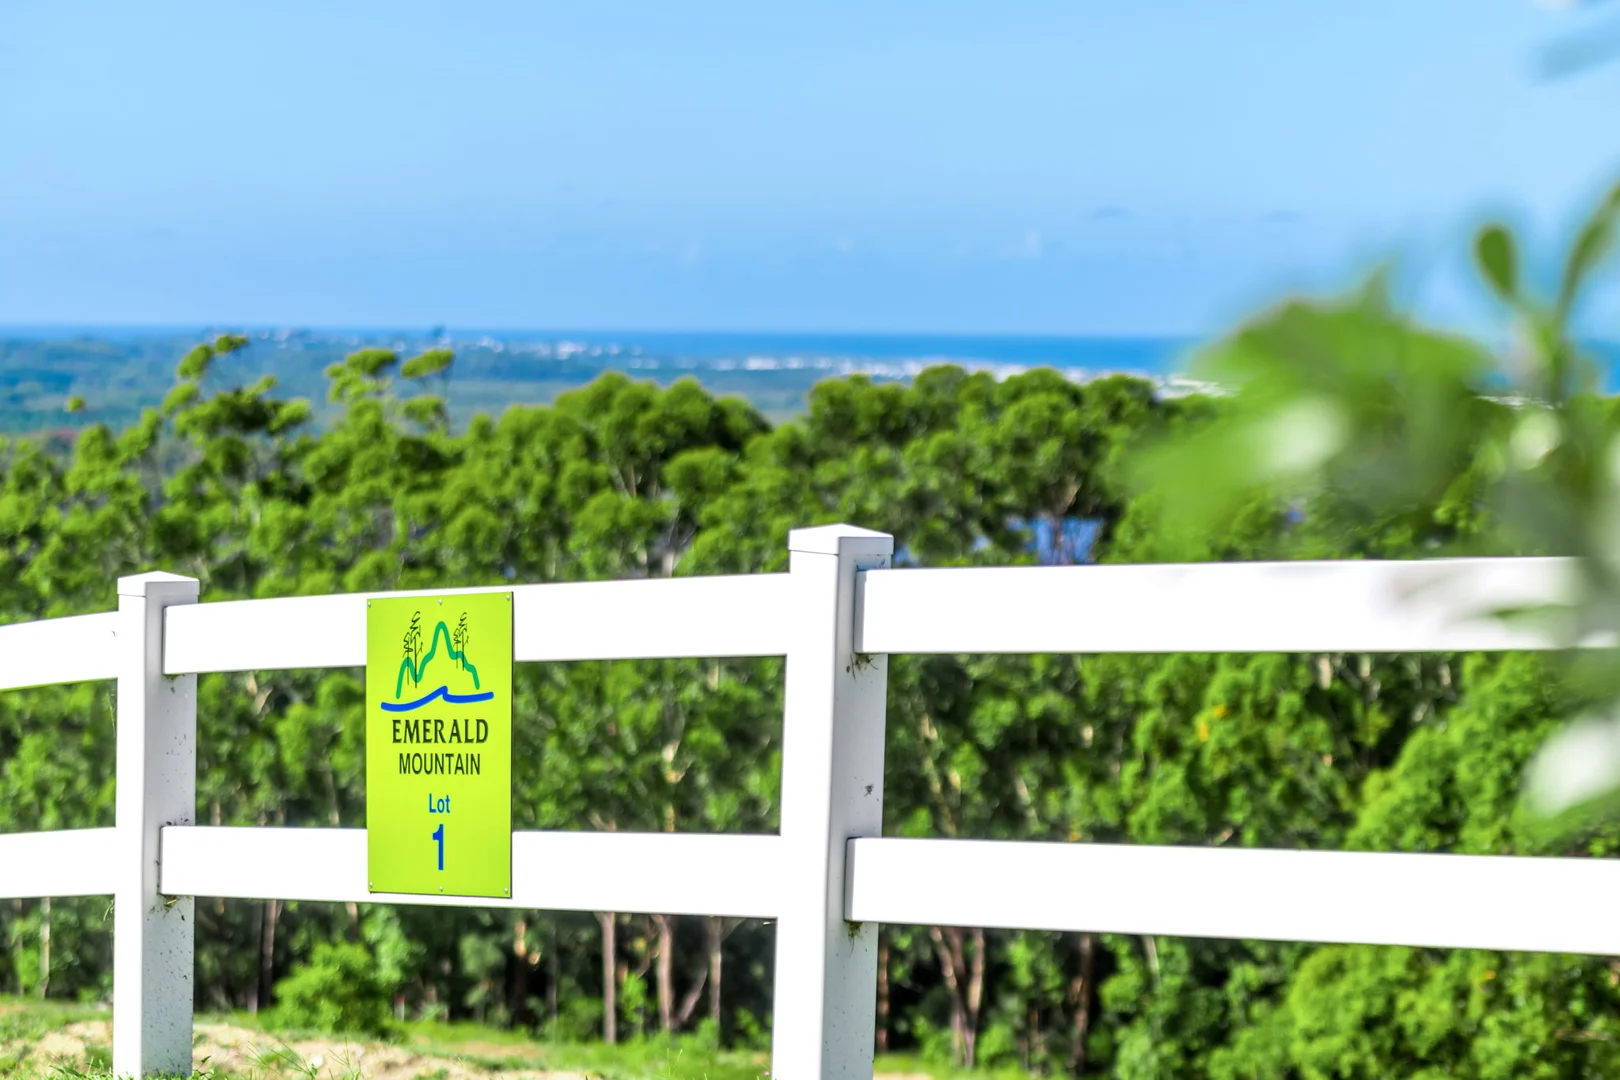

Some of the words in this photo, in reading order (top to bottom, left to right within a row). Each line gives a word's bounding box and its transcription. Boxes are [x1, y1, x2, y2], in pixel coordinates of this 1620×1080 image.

[392, 718, 489, 744] EMERALD
[399, 753, 481, 775] MOUNTAIN
[428, 793, 451, 814] Lot
[432, 823, 444, 871] 1
